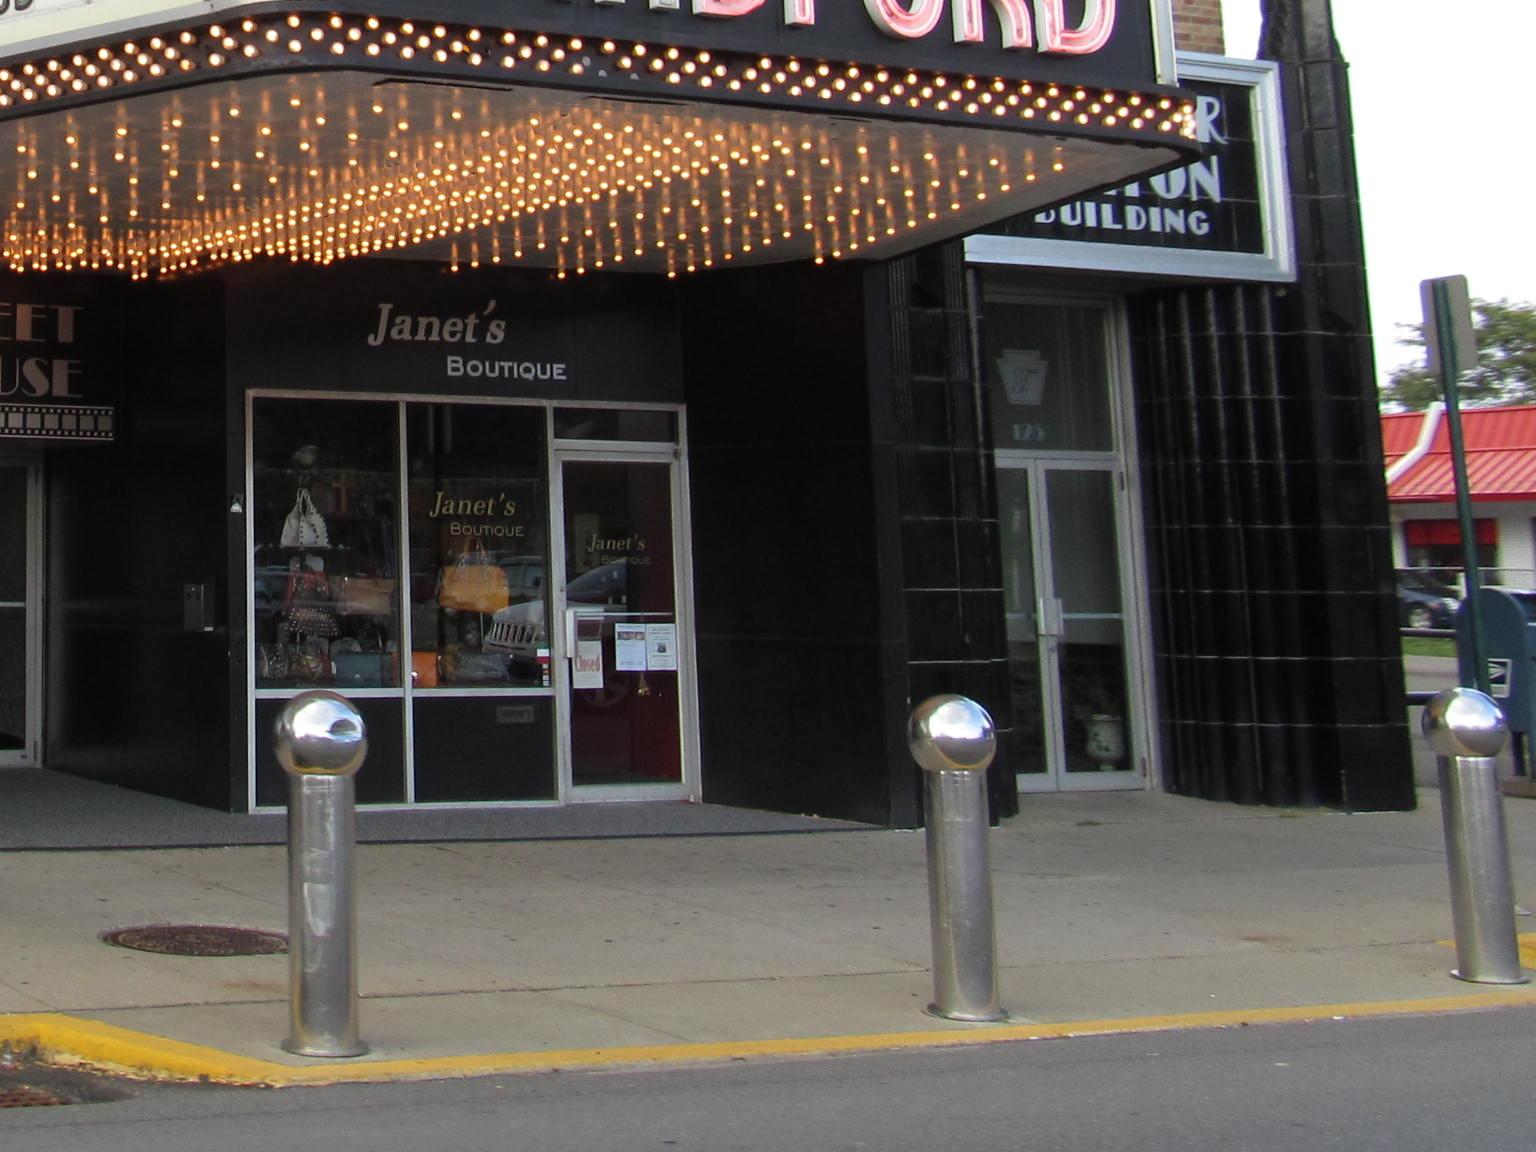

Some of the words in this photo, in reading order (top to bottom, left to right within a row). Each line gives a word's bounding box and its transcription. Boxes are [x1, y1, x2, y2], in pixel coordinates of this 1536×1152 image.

[367, 299, 506, 347] Janet's
[446, 355, 568, 381] BOUTIQUE
[429, 491, 516, 518] Janet's
[587, 533, 646, 553] Janet's
